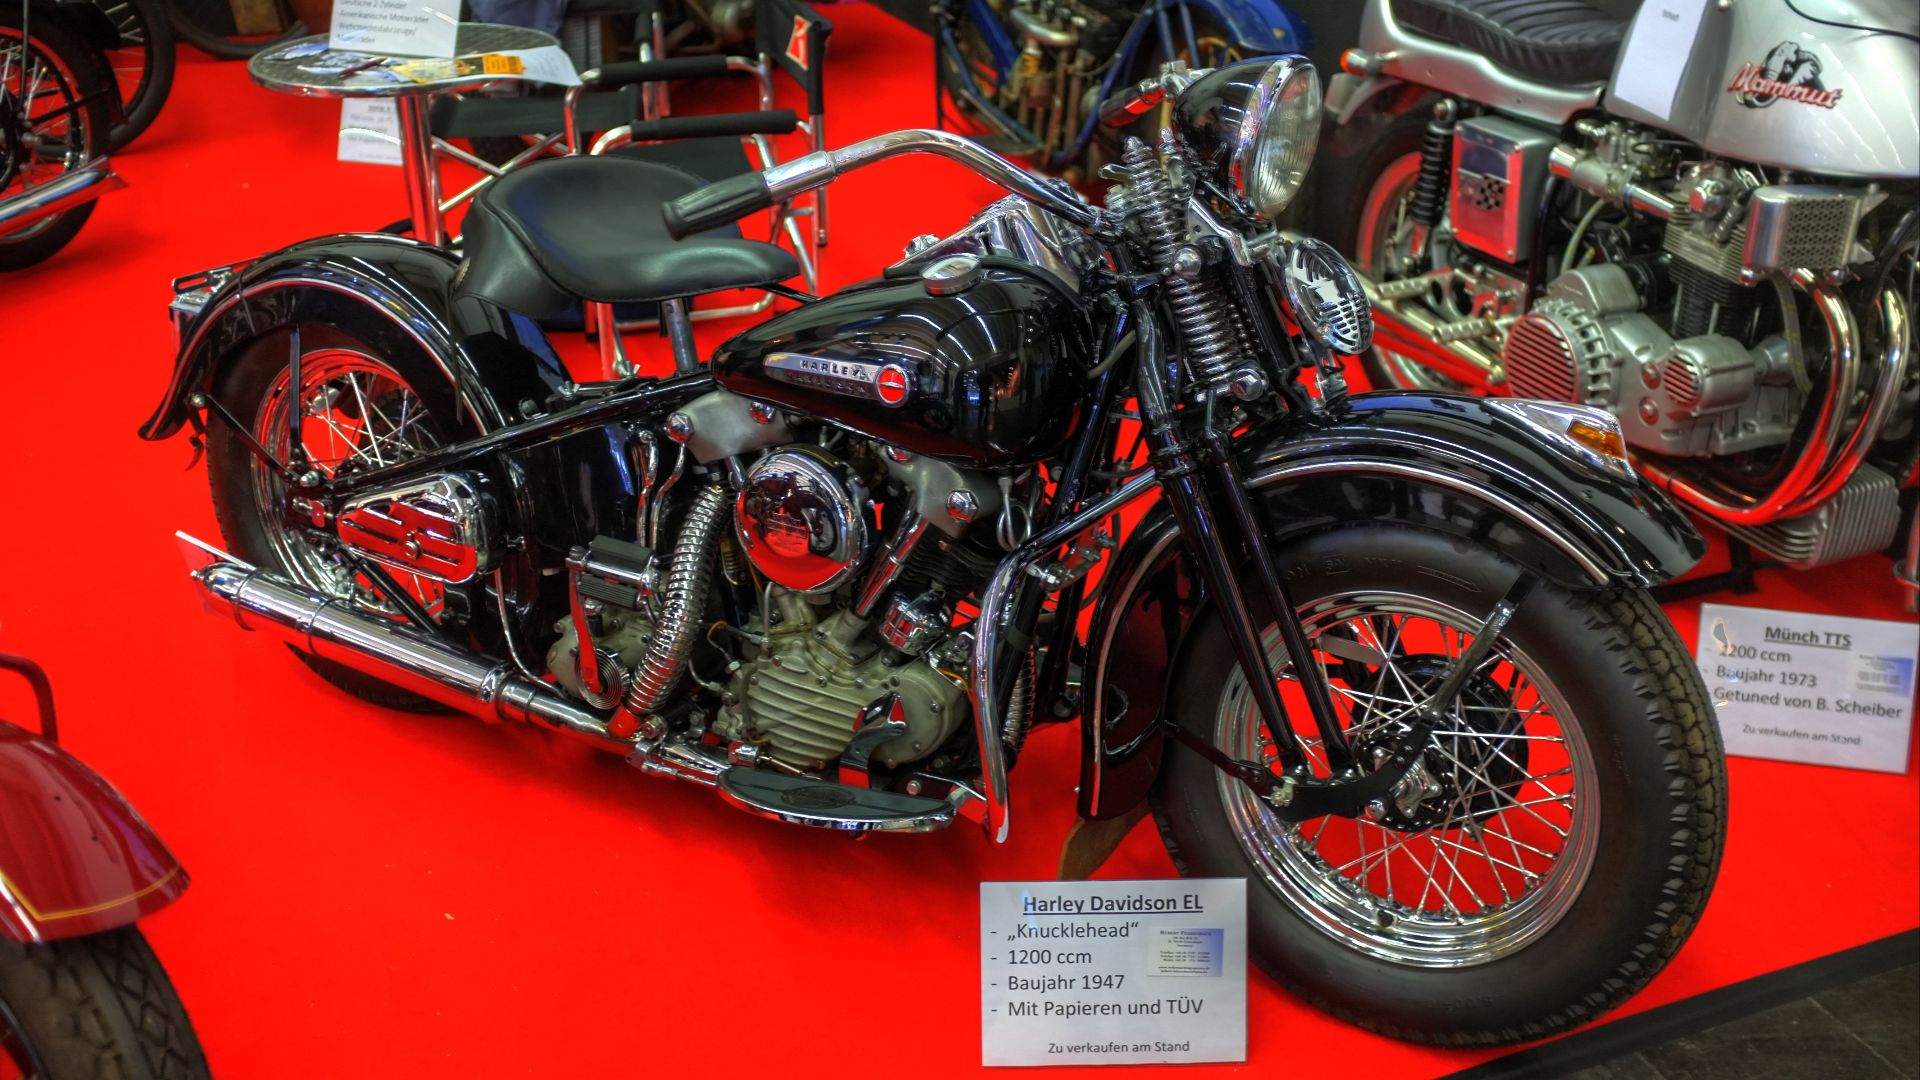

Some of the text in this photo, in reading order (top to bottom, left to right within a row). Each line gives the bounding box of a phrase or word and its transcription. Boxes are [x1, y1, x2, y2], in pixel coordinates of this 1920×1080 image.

[1728, 62, 1842, 109] Mammut
[1764, 626, 1852, 647] Münch TTS
[1760, 649, 1792, 663] ccm
[1717, 665, 1817, 688] Baujahr 1973
[1714, 687, 1903, 719] Getuned von B. Scheiber
[1742, 724, 1861, 746] Zu verkaufen am Stand
[1023, 894, 1203, 914] Harley Davidson EL
[1009, 950, 1051, 965] 1200
[1057, 952, 1092, 964] ccm
[1008, 975, 1076, 993] Baujahr
[1082, 974, 1125, 989] 1947
[1008, 1001, 1038, 1016] Mit
[1044, 1000, 1121, 1019] Papieren
[1128, 999, 1160, 1015] und
[1166, 995, 1203, 1014] TÜV
[1048, 1041, 1190, 1054] Zu verkaufen am Stand
